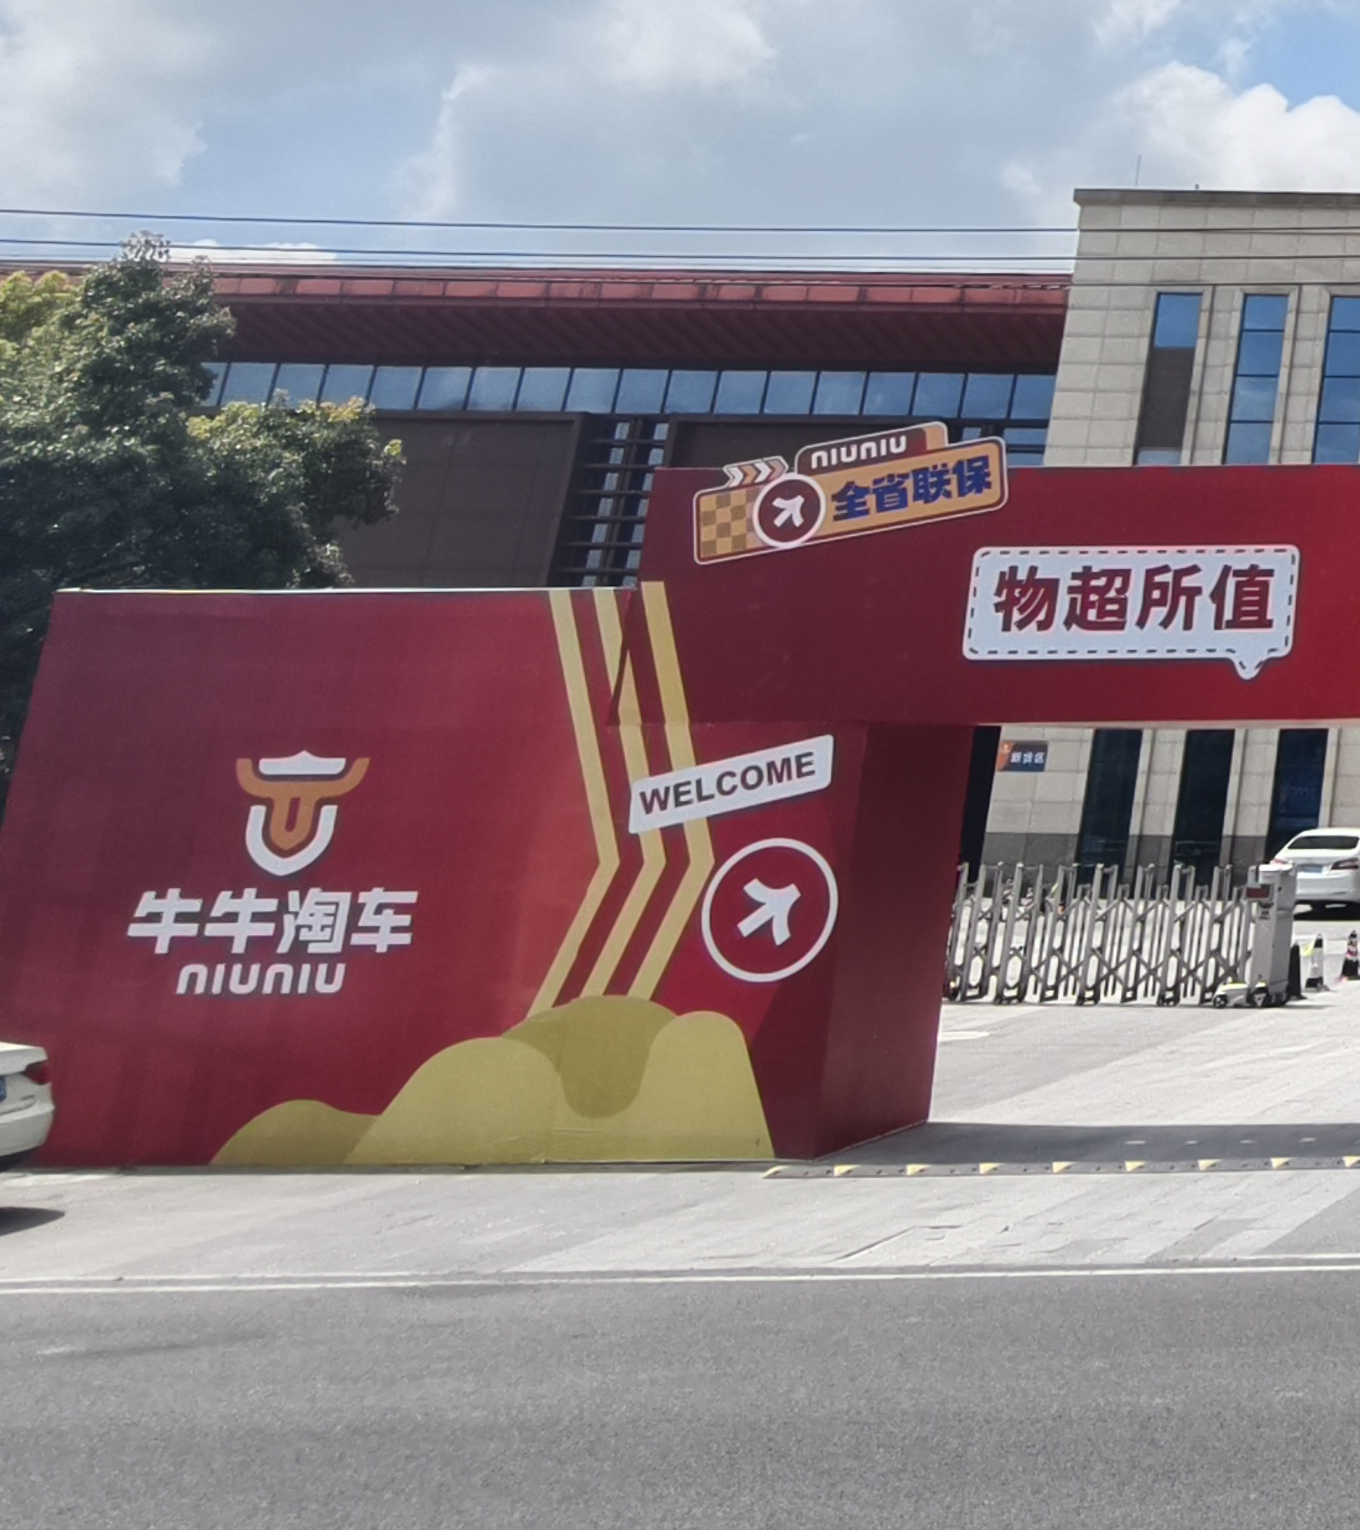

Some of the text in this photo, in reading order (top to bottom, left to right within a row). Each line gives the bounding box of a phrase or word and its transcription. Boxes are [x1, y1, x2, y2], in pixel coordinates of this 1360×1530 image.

[831, 454, 992, 521] 全省联保
[993, 564, 1275, 633] 物超所值
[638, 751, 817, 816] WELCOME
[127, 887, 418, 954] 牛牛淘车
